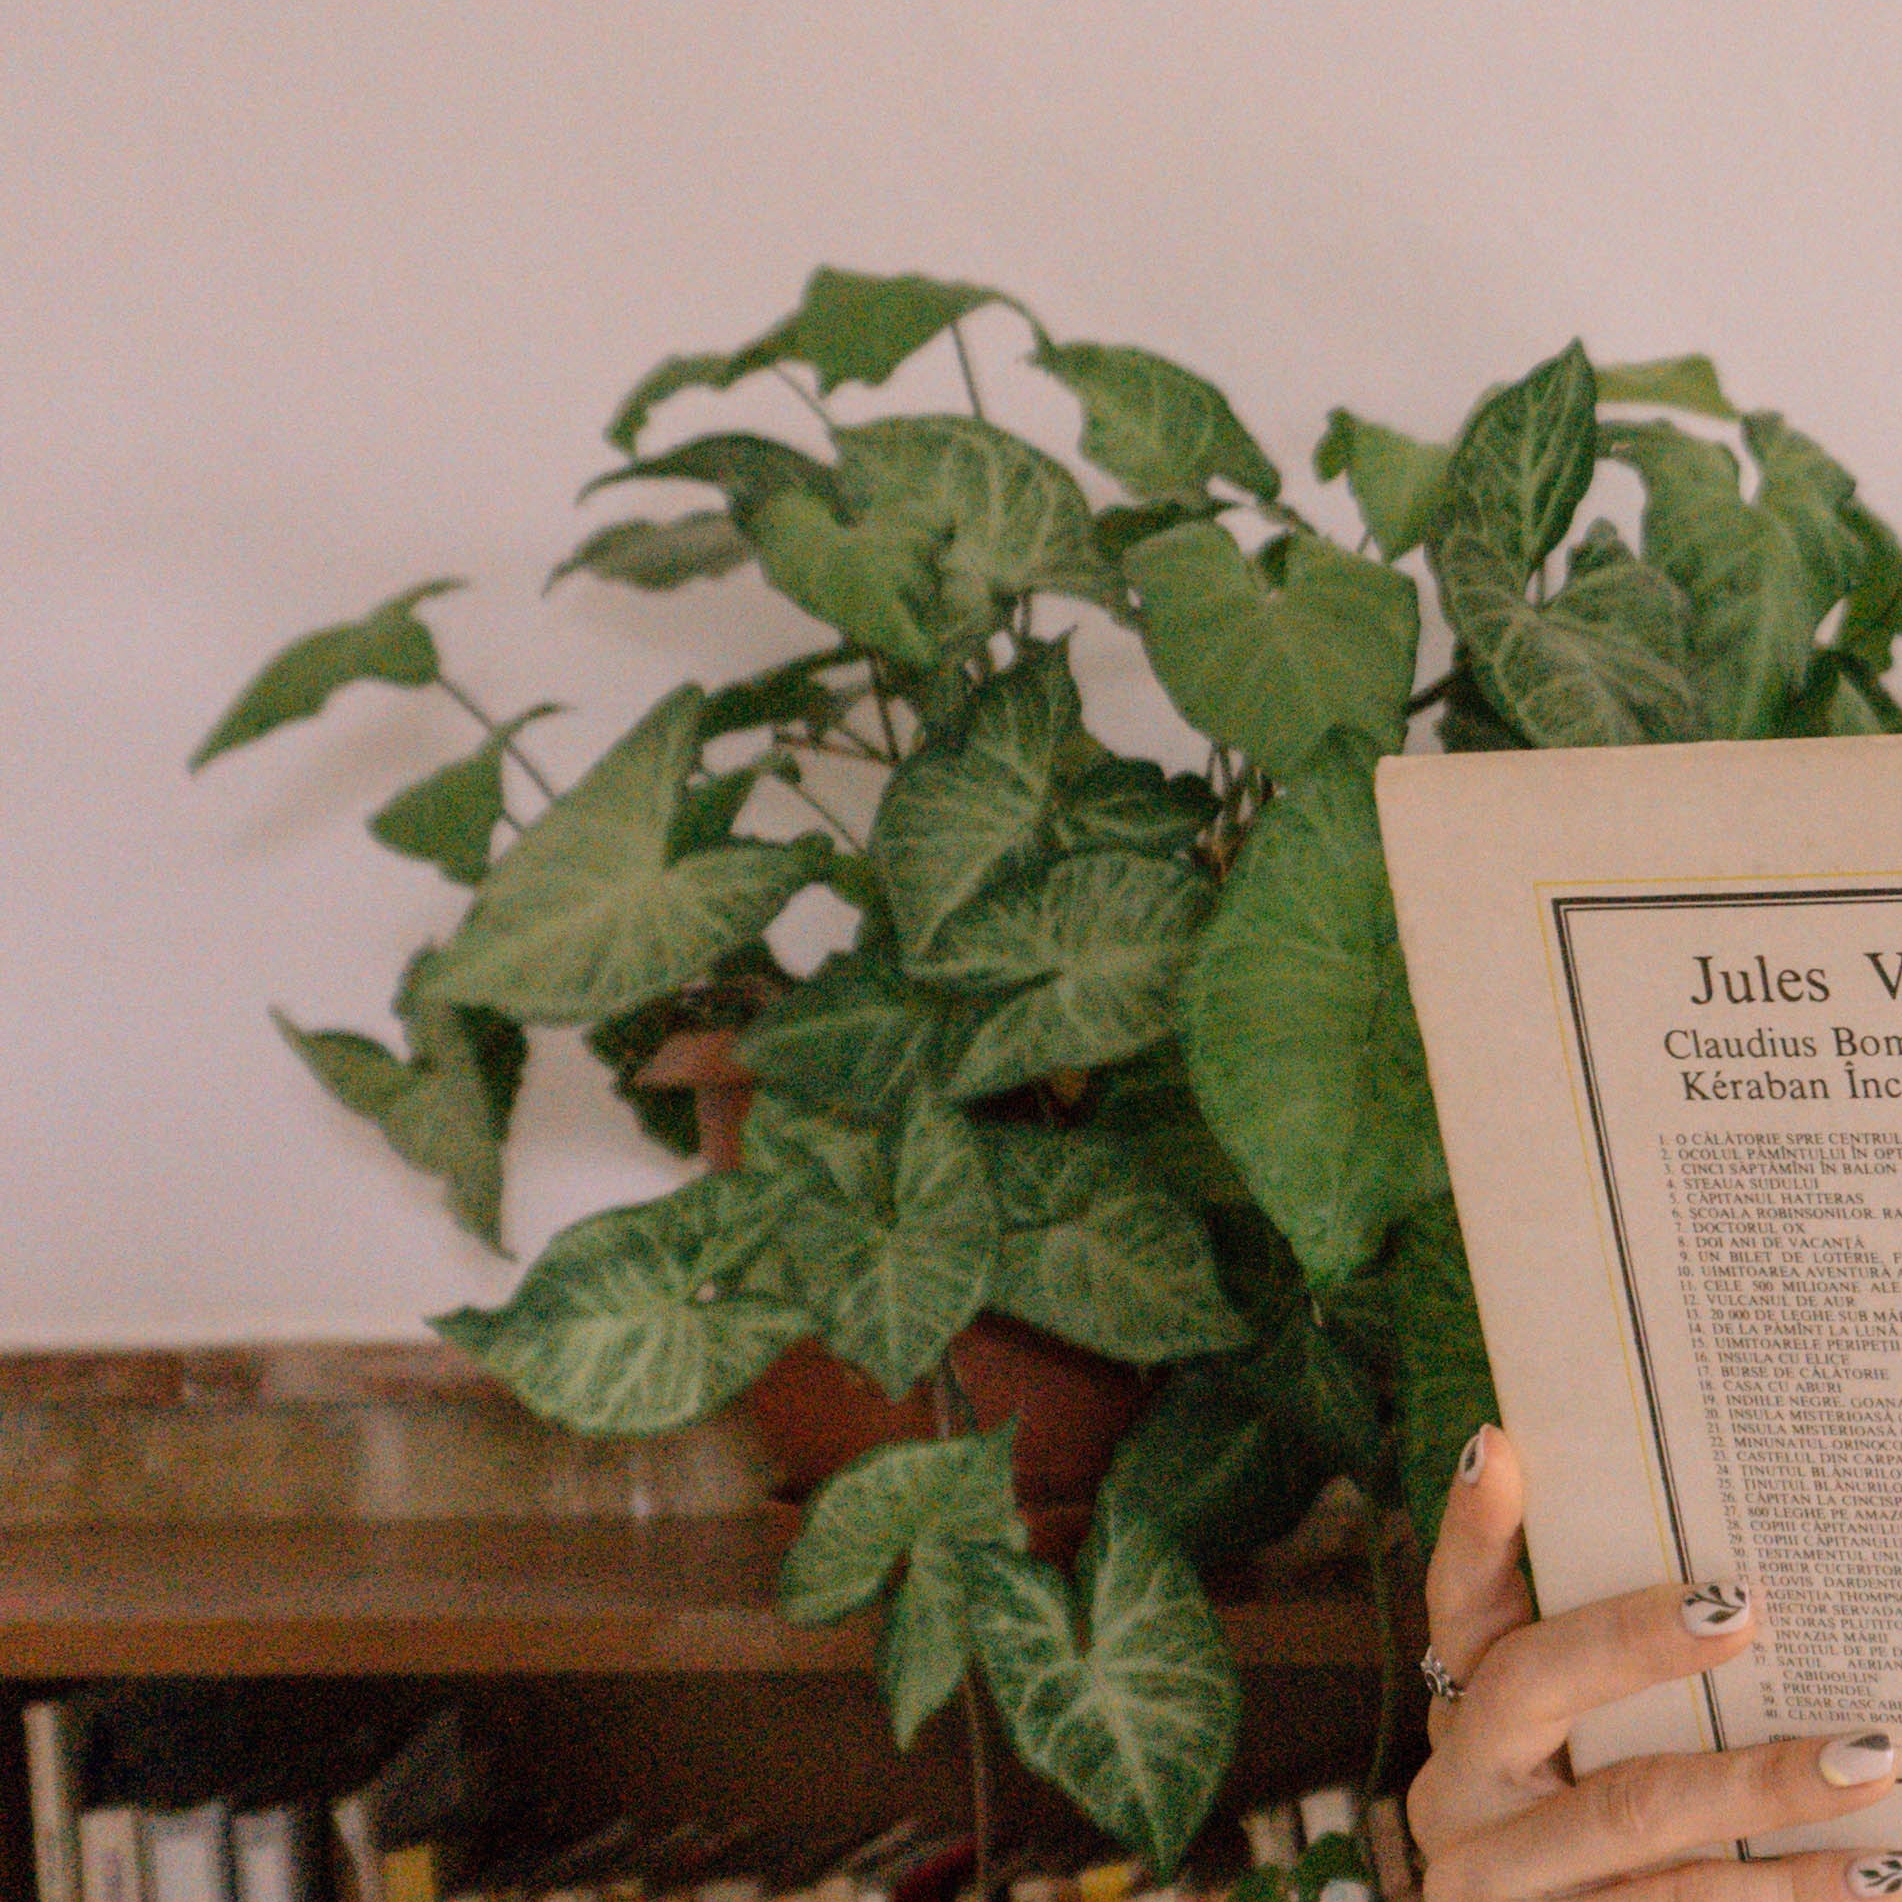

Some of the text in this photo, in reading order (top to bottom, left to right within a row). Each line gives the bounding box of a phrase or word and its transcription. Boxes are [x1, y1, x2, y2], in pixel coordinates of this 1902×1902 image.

[1690, 954, 1830, 1006] Jules
[1664, 1027, 1817, 1060] Claudius
[1682, 1069, 1830, 1102] Kéraban
[1676, 1134, 1687, 1146] O
[1786, 1133, 1823, 1145] SPRE
[1678, 1148, 1742, 1160] OCOLUL
[1681, 1163, 1725, 1175] CINCI
[1843, 1162, 1897, 1174] BALON
[1683, 1178, 1819, 1190] STEAUA SUDULUI
[1780, 1193, 1865, 1205] HATTERAS
[1693, 1222, 1806, 1234] DOCTORUL OX
[1696, 1237, 1724, 1248] DOI
[1730, 1237, 1756, 1248] ANI
[1762, 1237, 1783, 1248] DE
[1699, 1251, 1720, 1263] UN
[1730, 1251, 1773, 1263] BILET
[1782, 1251, 1803, 1263] DE
[1701, 1266, 1801, 1278] UIMITOAREA
[1703, 1281, 1742, 1292] CELE
[1782, 1281, 1860, 1293] MILIOANE
[1706, 1295, 1856, 1308] VULCANUL DE AUR
[1755, 1309, 1775, 1321] DE
[1781, 1310, 1834, 1322] LEGHE
[1838, 1310, 1868, 1322] SUB
[1712, 1323, 1732, 1335] DE
[1739, 1323, 1758, 1335] LA
[1829, 1324, 1849, 1336] LA
[1714, 1337, 1823, 1350] UIMITOARELE
[1717, 1351, 1850, 1365] INSULA CU ELICE
[1721, 1366, 1769, 1378] BURSE
[1774, 1367, 1794, 1379] DE
[1723, 1380, 1842, 1394] CASA CU ABURI
[1726, 1395, 1785, 1407] INDIILE
